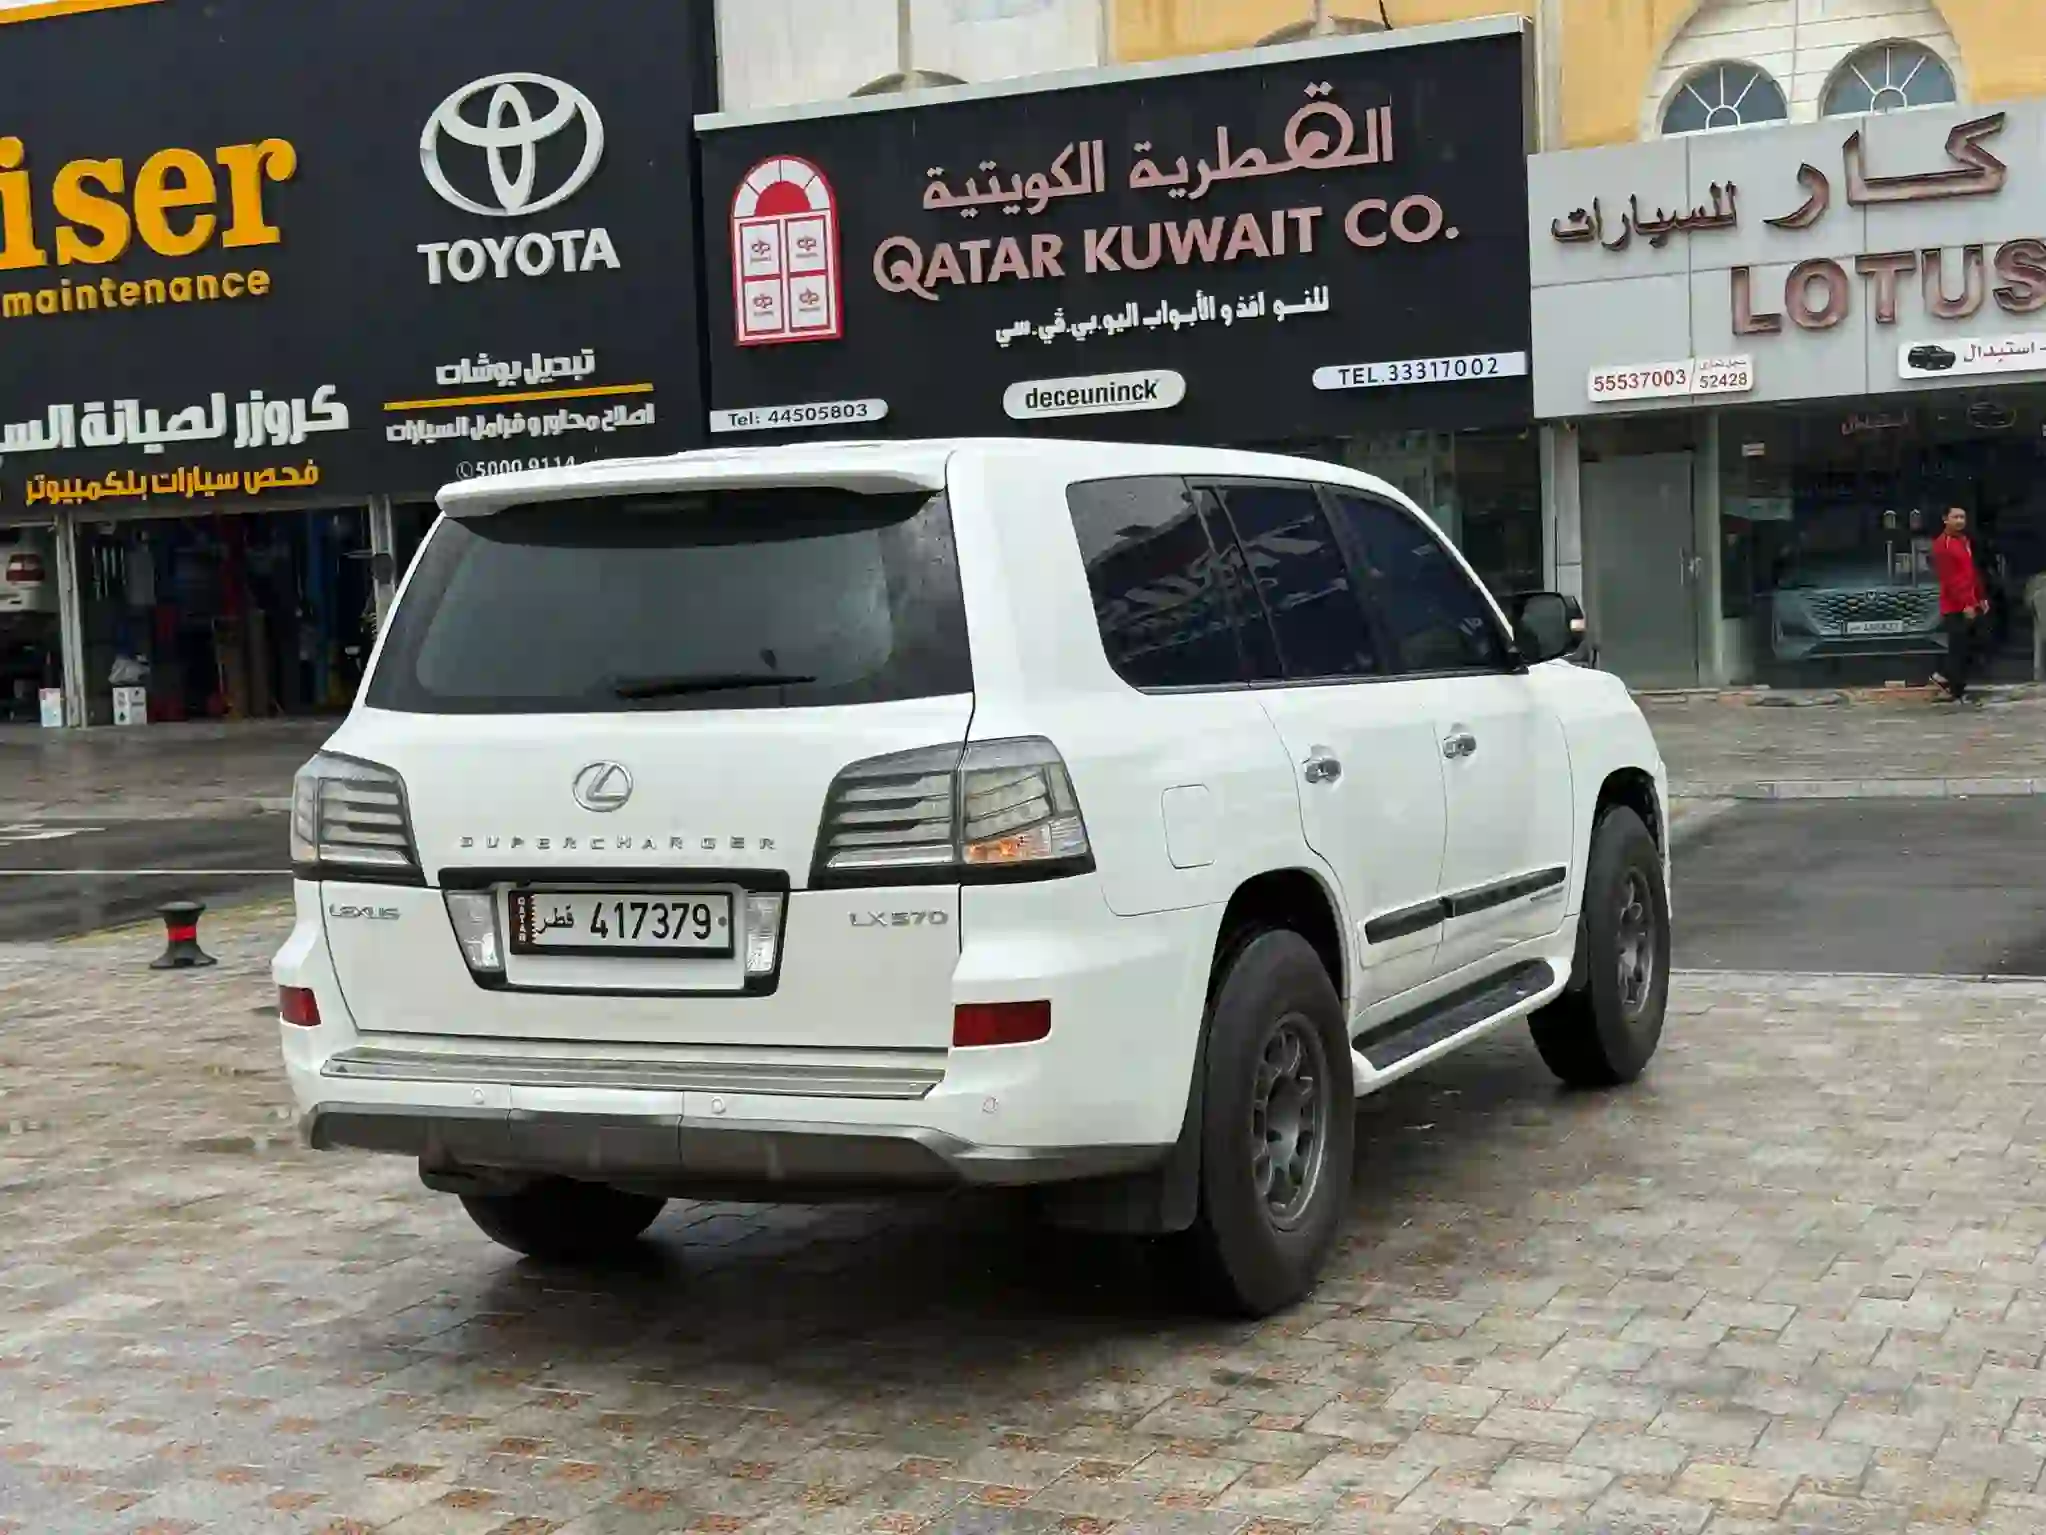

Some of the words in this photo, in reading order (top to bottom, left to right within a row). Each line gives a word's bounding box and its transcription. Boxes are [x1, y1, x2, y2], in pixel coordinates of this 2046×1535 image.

[1129, 80, 1394, 200] القطرية
[923, 140, 1105, 218] الكويتية
[1763, 111, 2007, 230] كار
[1551, 180, 1738, 251] للسيارات
[417, 228, 621, 284] TOYOTA
[873, 233, 1066, 300] QATAR
[1084, 206, 1323, 274] KUWAIT
[1344, 193, 1460, 248] CO.
[3, 269, 271, 318] maintenance
[1730, 238, 2046, 337] LOTUS
[524, 348, 596, 384] تبديل
[1963, 341, 2035, 363] استبدال
[1025, 377, 1158, 410] deceuninck
[1593, 369, 1686, 392] 55537003
[1699, 372, 1748, 389] 52428
[81, 392, 228, 454] لصيانة
[234, 384, 349, 449] كروزر
[386, 415, 470, 445] السيارات
[470, 412, 526, 441] فرامل
[543, 409, 600, 437] محاور
[728, 411, 760, 427] Tel:
[767, 403, 868, 424] 44505803
[152, 465, 239, 498] سيارات
[244, 458, 319, 495] فحص
[475, 459, 523, 478] 5000
[459, 835, 776, 850] SUPERCHARGER
[328, 903, 401, 921] LEXUS
[535, 904, 574, 934] قطر
[590, 902, 711, 940] 417379
